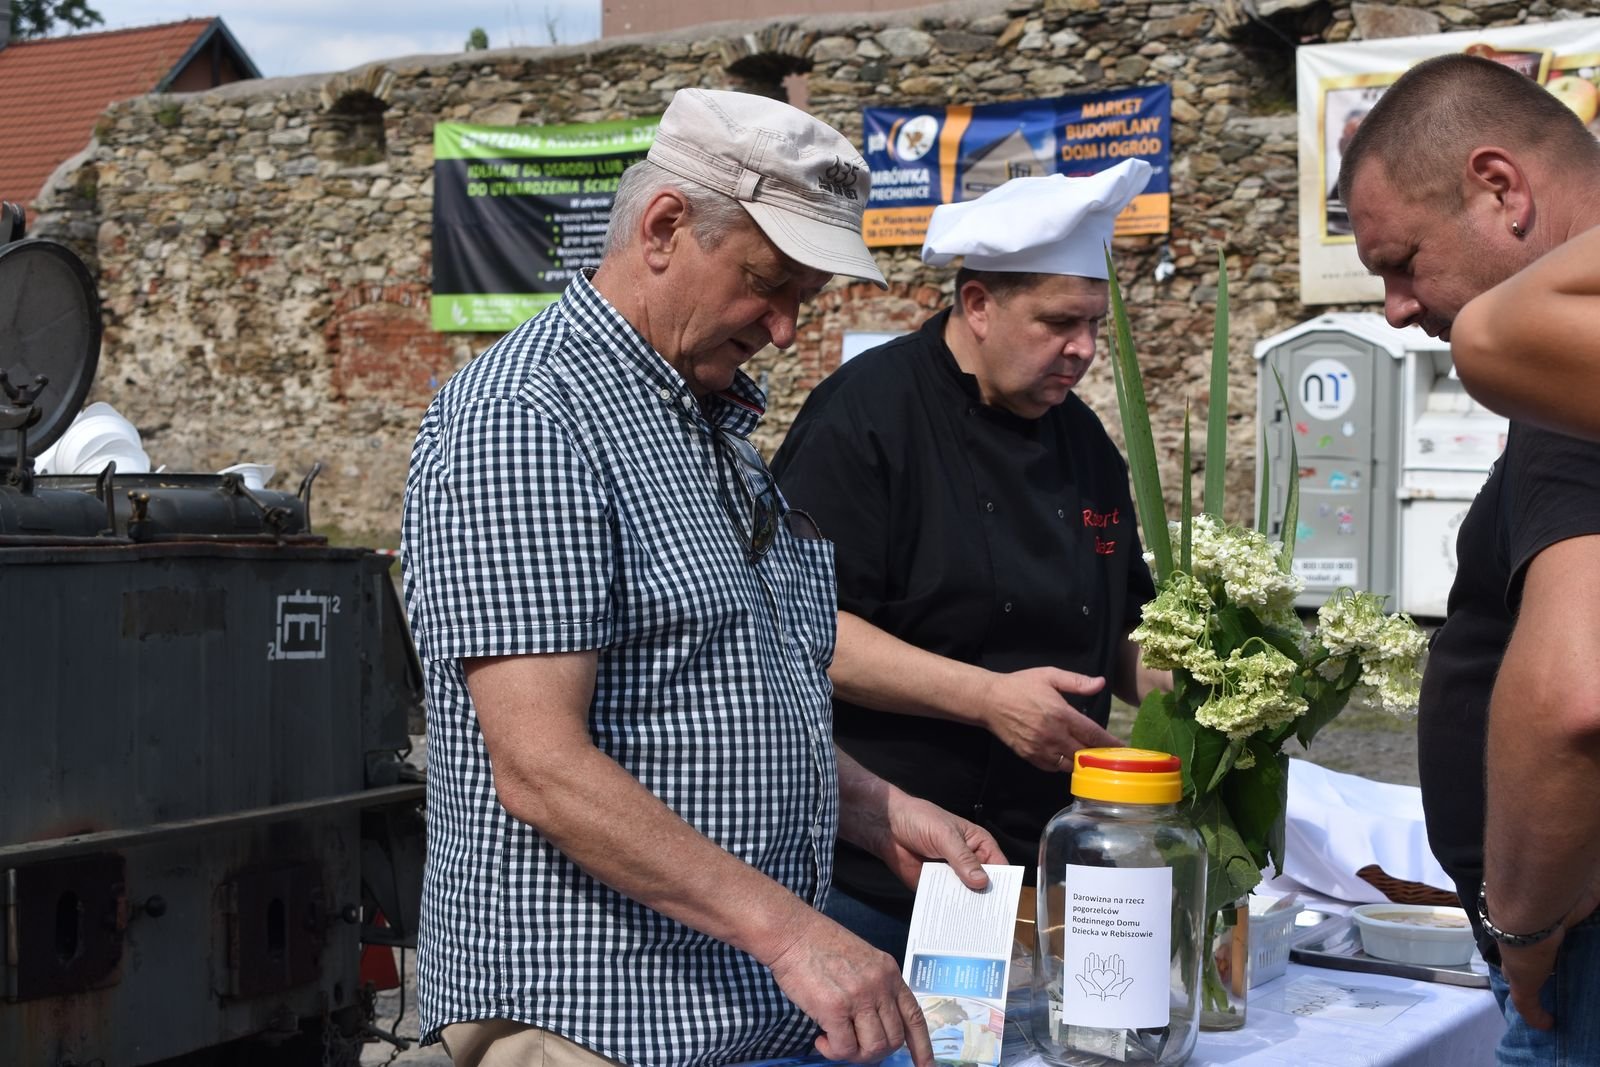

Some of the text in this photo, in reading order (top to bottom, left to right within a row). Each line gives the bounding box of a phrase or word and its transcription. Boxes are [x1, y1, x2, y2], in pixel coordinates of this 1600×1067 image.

[1081, 97, 1143, 118] MARKET
[1066, 116, 1161, 140] BUDOWLANY
[1061, 136, 1162, 161] DOM I OGRÓD
[522, 163, 541, 178] DO
[870, 166, 930, 186] MRÓWKA
[467, 182, 487, 198] DO
[869, 185, 930, 201] PIECHOWICE
[1073, 893, 1112, 904] Darowizna
[1072, 905, 1119, 915] pogorzelców
[1072, 915, 1140, 927] Rodzinnego Domu
[1072, 926, 1099, 936] Dziecka
[1110, 929, 1154, 938] Rębiszowie
